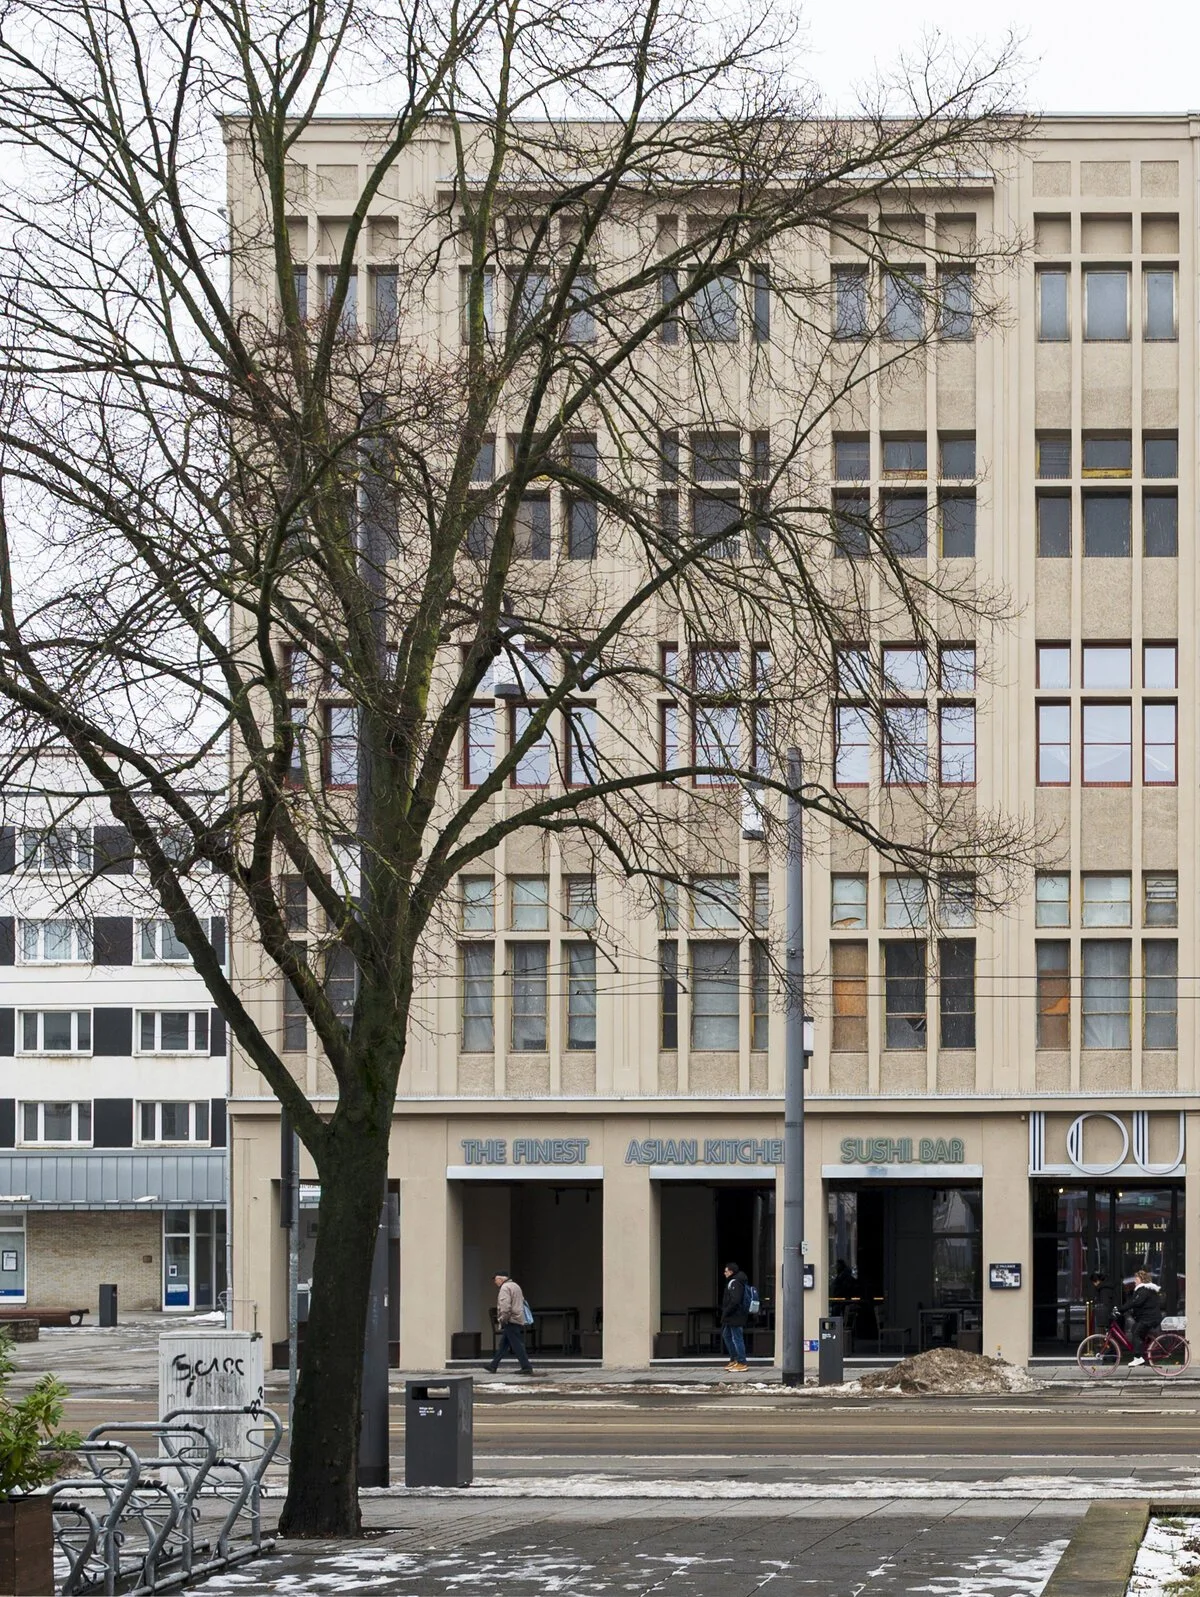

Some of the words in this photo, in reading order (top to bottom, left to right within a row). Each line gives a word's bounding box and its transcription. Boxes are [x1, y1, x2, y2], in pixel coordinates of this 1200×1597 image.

[461, 1138, 507, 1165] THE
[513, 1138, 590, 1165] FINEST
[624, 1138, 698, 1165] ASIAN
[704, 1138, 785, 1165] KITCHE
[840, 1137, 912, 1164] SUSHI
[918, 1137, 965, 1164] BAR
[1030, 1110, 1186, 1175] LOU
